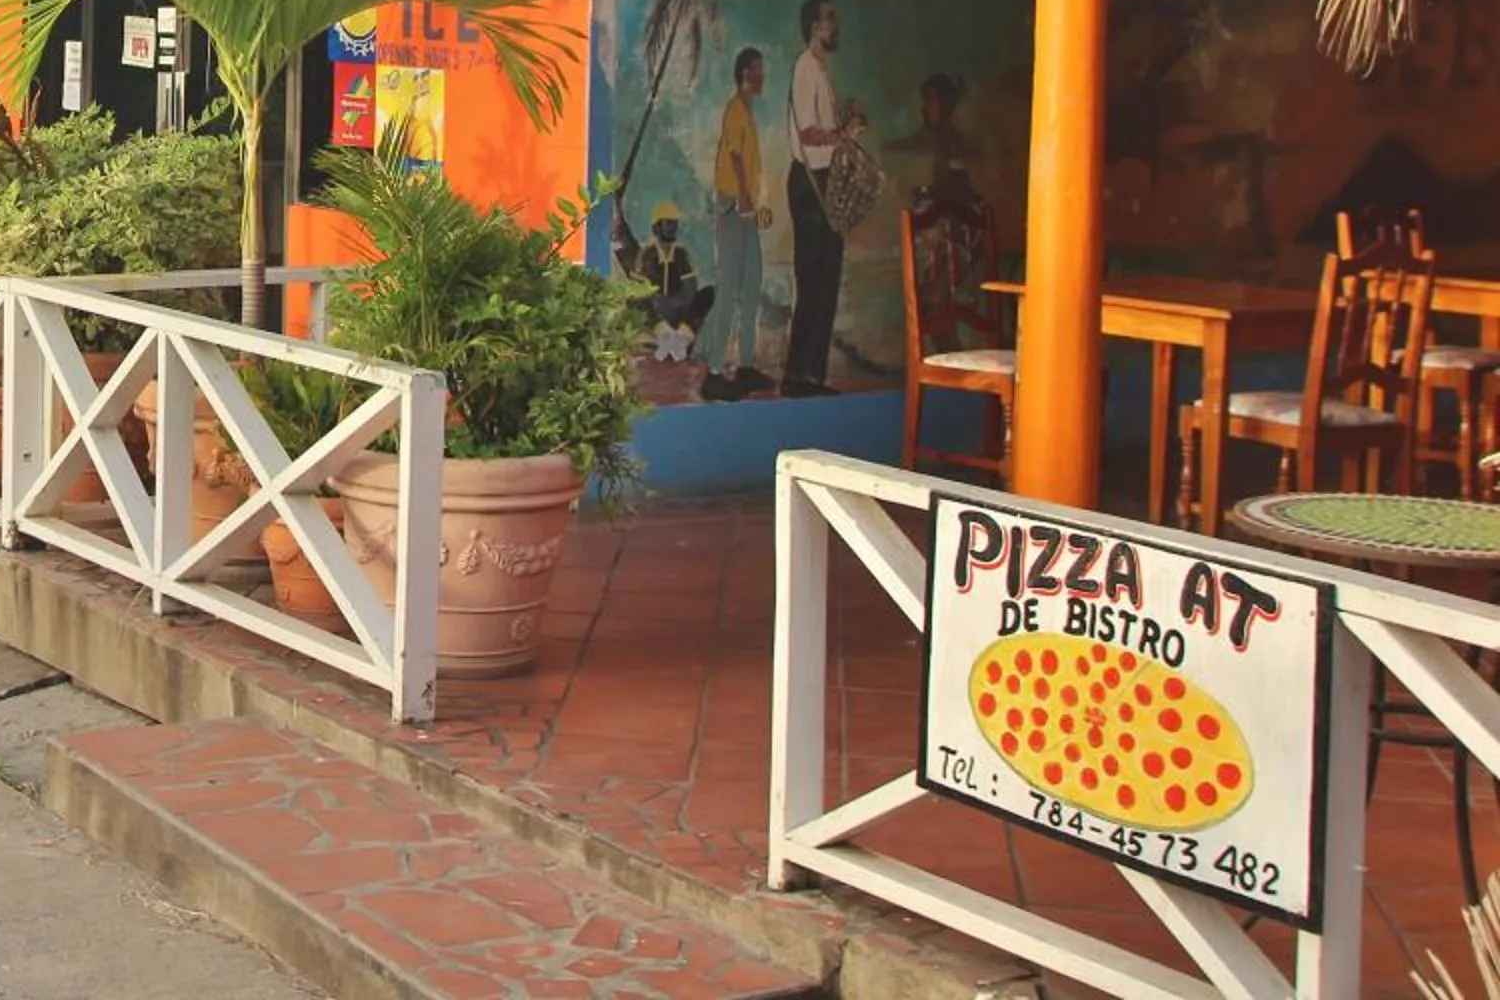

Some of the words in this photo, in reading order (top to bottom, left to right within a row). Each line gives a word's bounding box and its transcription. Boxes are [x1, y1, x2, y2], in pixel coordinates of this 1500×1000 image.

[954, 510, 1144, 608] PIZZA
[1180, 561, 1283, 652] AT
[997, 598, 1040, 638] DE
[1062, 597, 1186, 669] BISTRO
